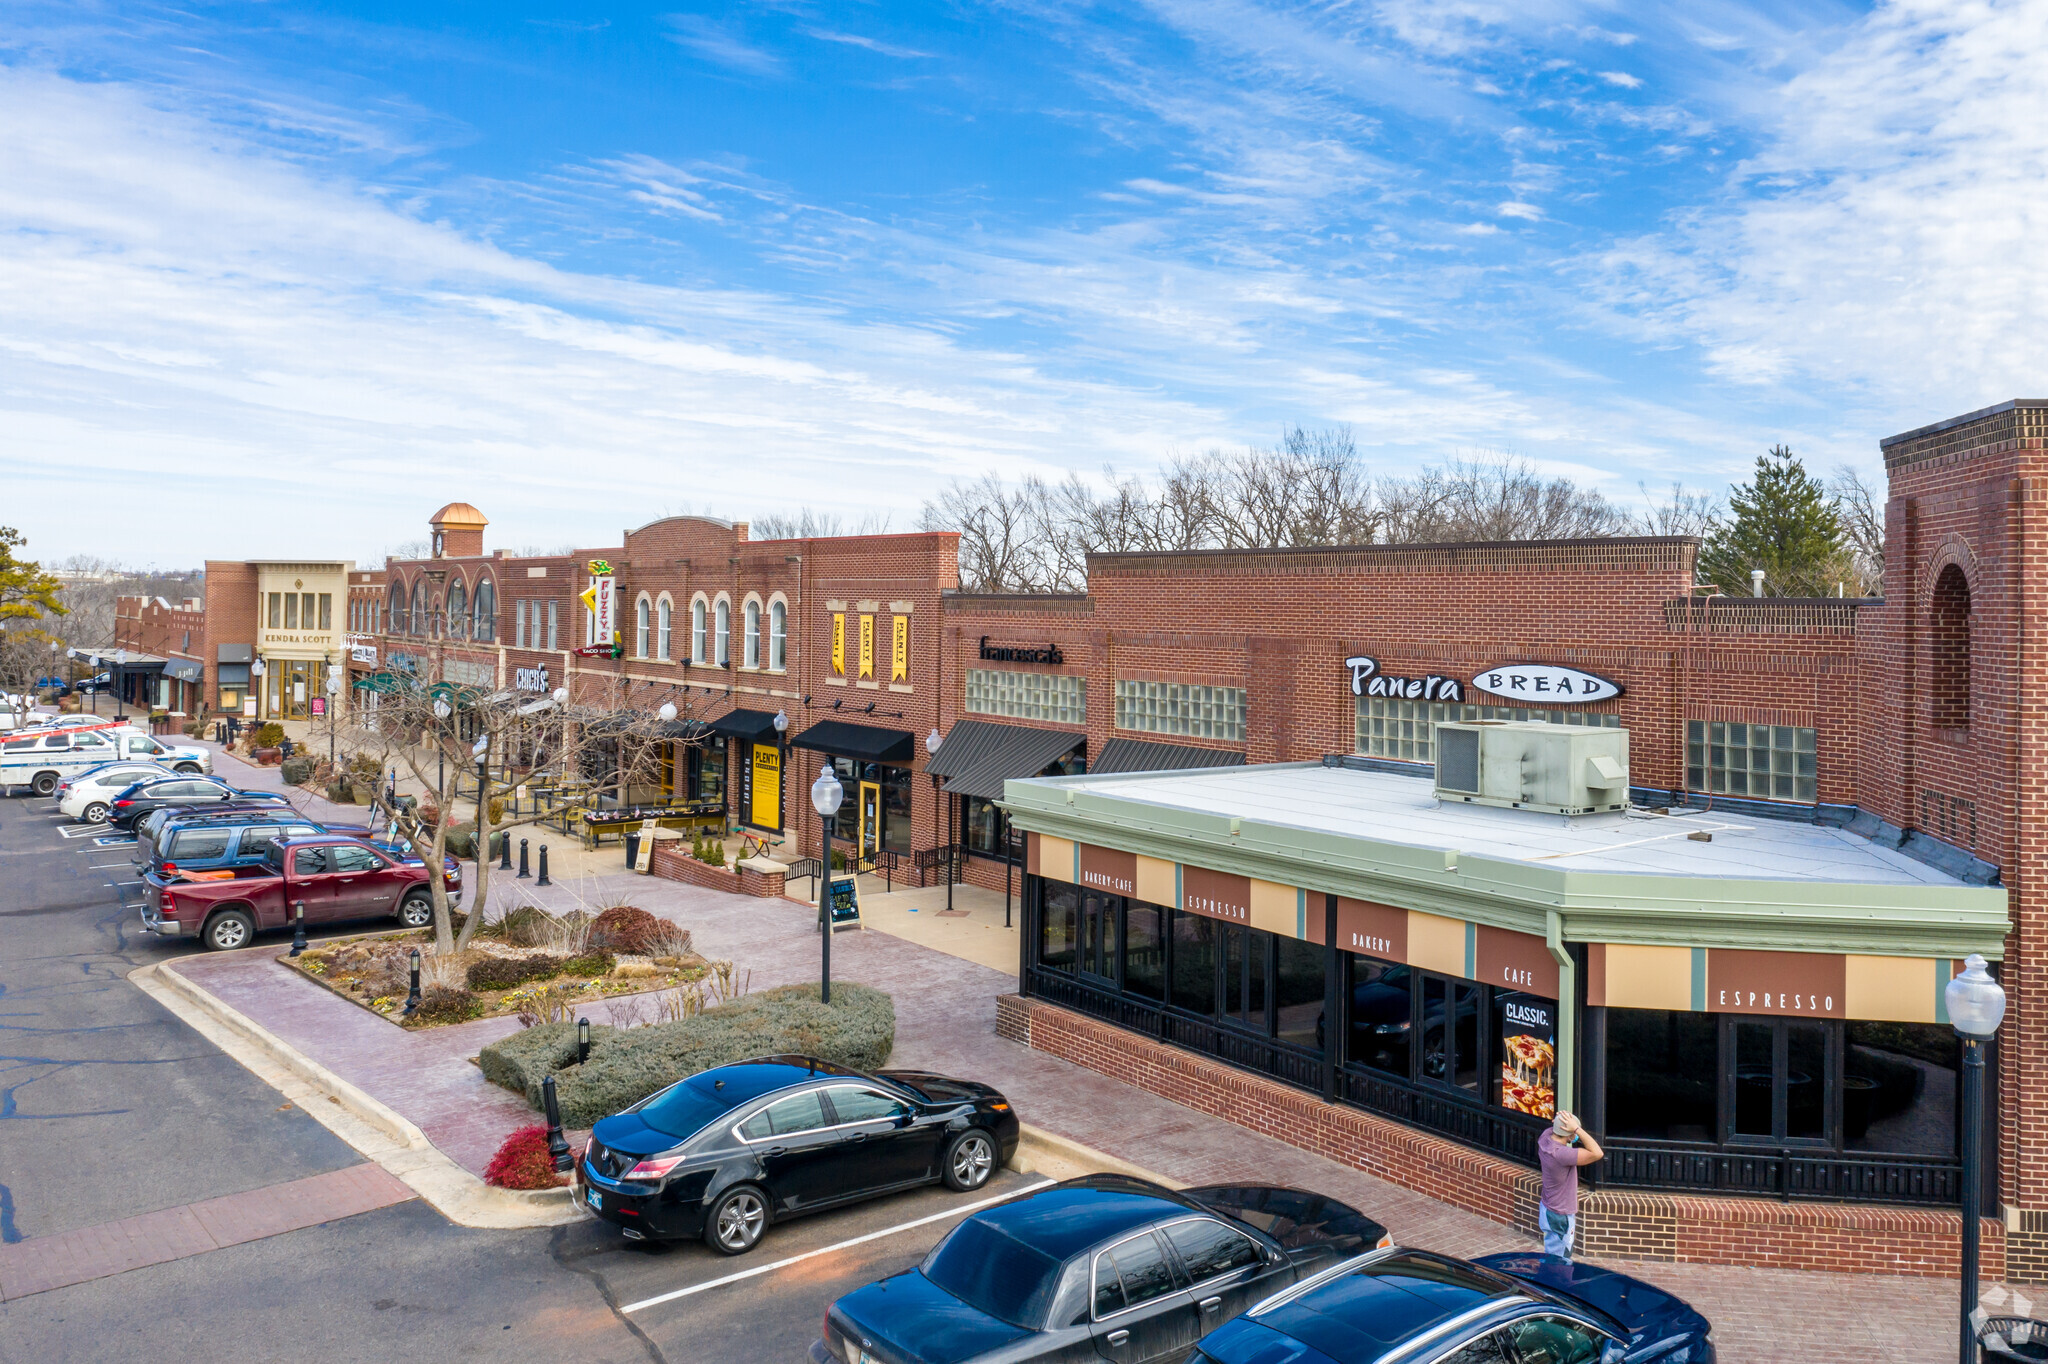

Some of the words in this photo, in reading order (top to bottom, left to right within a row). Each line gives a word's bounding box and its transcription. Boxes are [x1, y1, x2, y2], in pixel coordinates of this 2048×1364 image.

[600, 580, 610, 641] FUZZY'S
[265, 634, 300, 643] KENDRA
[303, 635, 332, 644] SCOTT
[979, 634, 1064, 664] francesca's
[516, 662, 547, 692] CHICO'S
[1345, 656, 1462, 701] Panera
[1488, 673, 1601, 695] BREAD
[755, 750, 779, 766] PLENTY
[1084, 870, 1132, 893] BAKERY-CAFE
[1189, 895, 1245, 919] ESPRESSO
[1352, 932, 1391, 953] BAKERY
[1504, 966, 1532, 987] CAFE
[1720, 989, 1833, 1011] ESPRESSO
[1506, 1002, 1549, 1026] CLASSIC.
